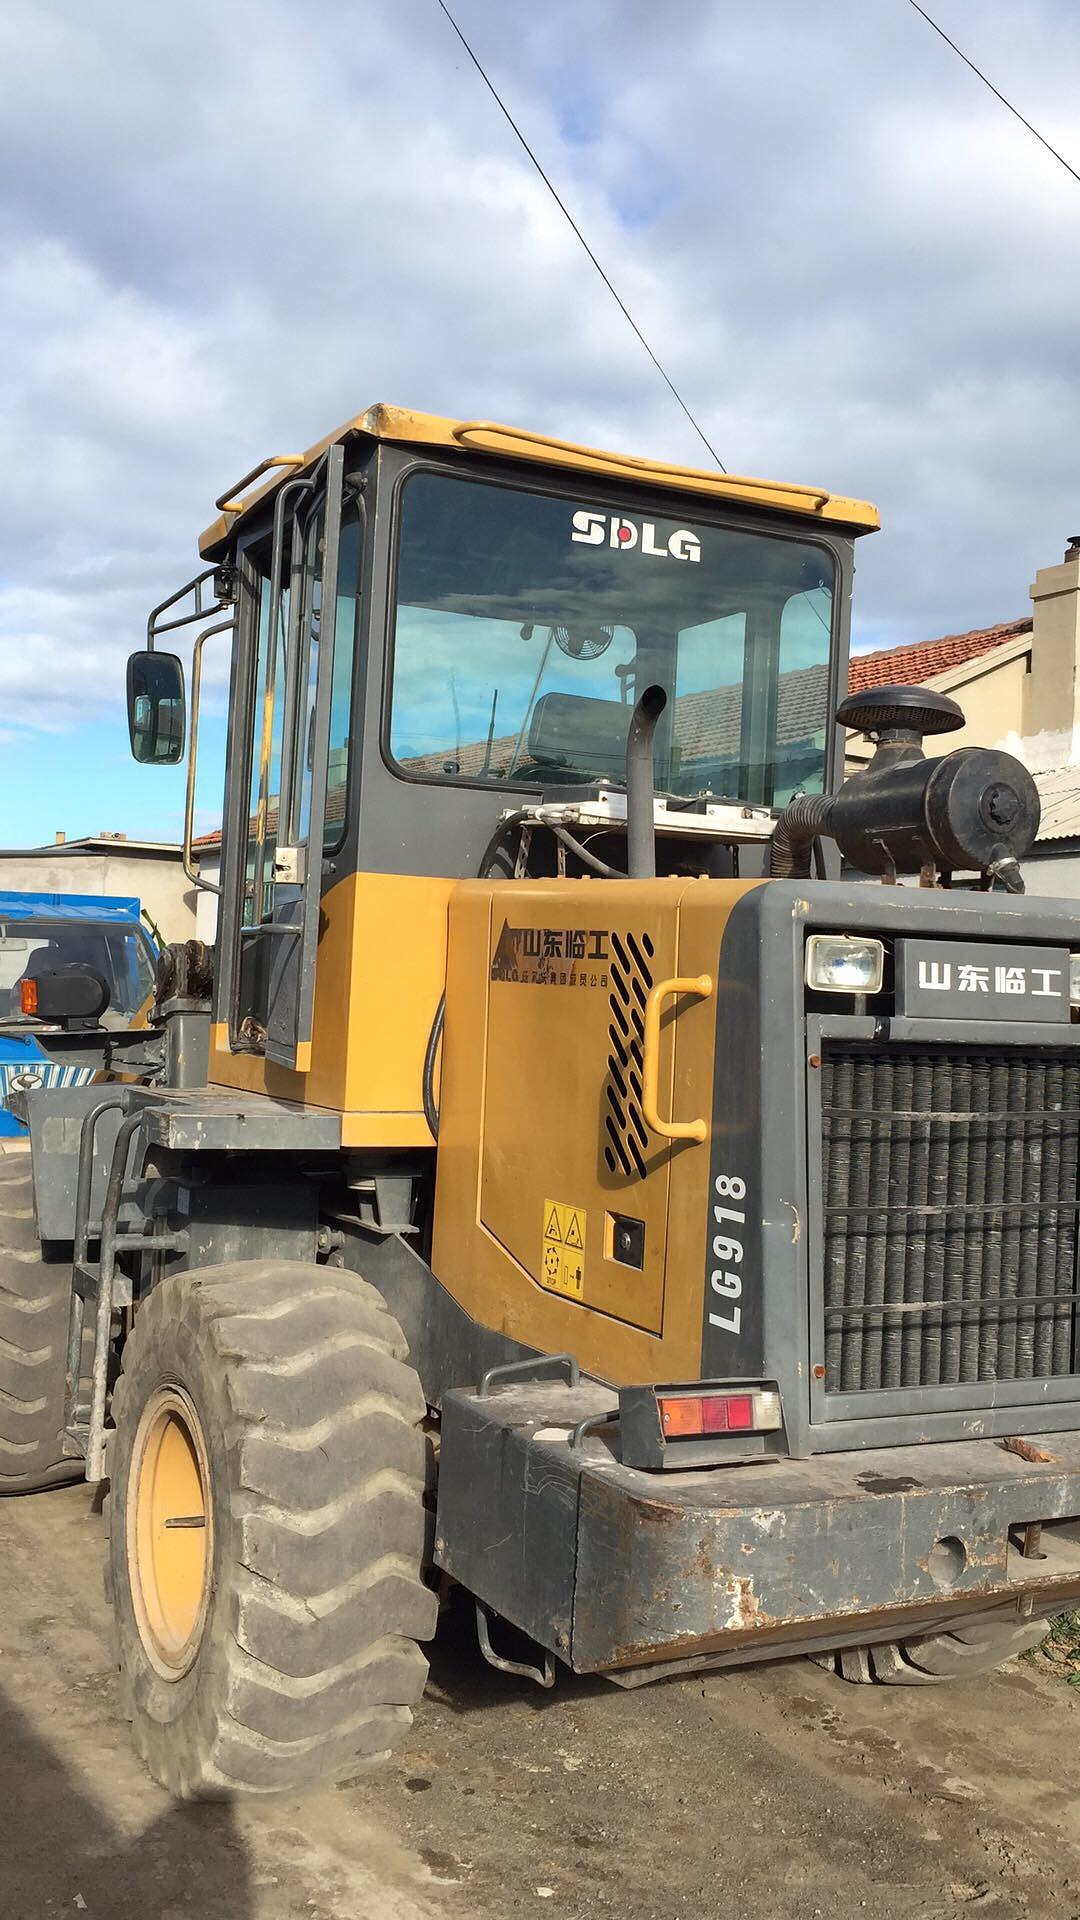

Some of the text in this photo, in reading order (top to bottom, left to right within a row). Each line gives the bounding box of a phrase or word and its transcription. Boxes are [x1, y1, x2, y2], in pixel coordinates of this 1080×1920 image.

[571, 510, 701, 563] SDLG
[523, 929, 609, 960] 山东临工
[918, 961, 1062, 997] 山东临工
[708, 1174, 747, 1335] LG918
